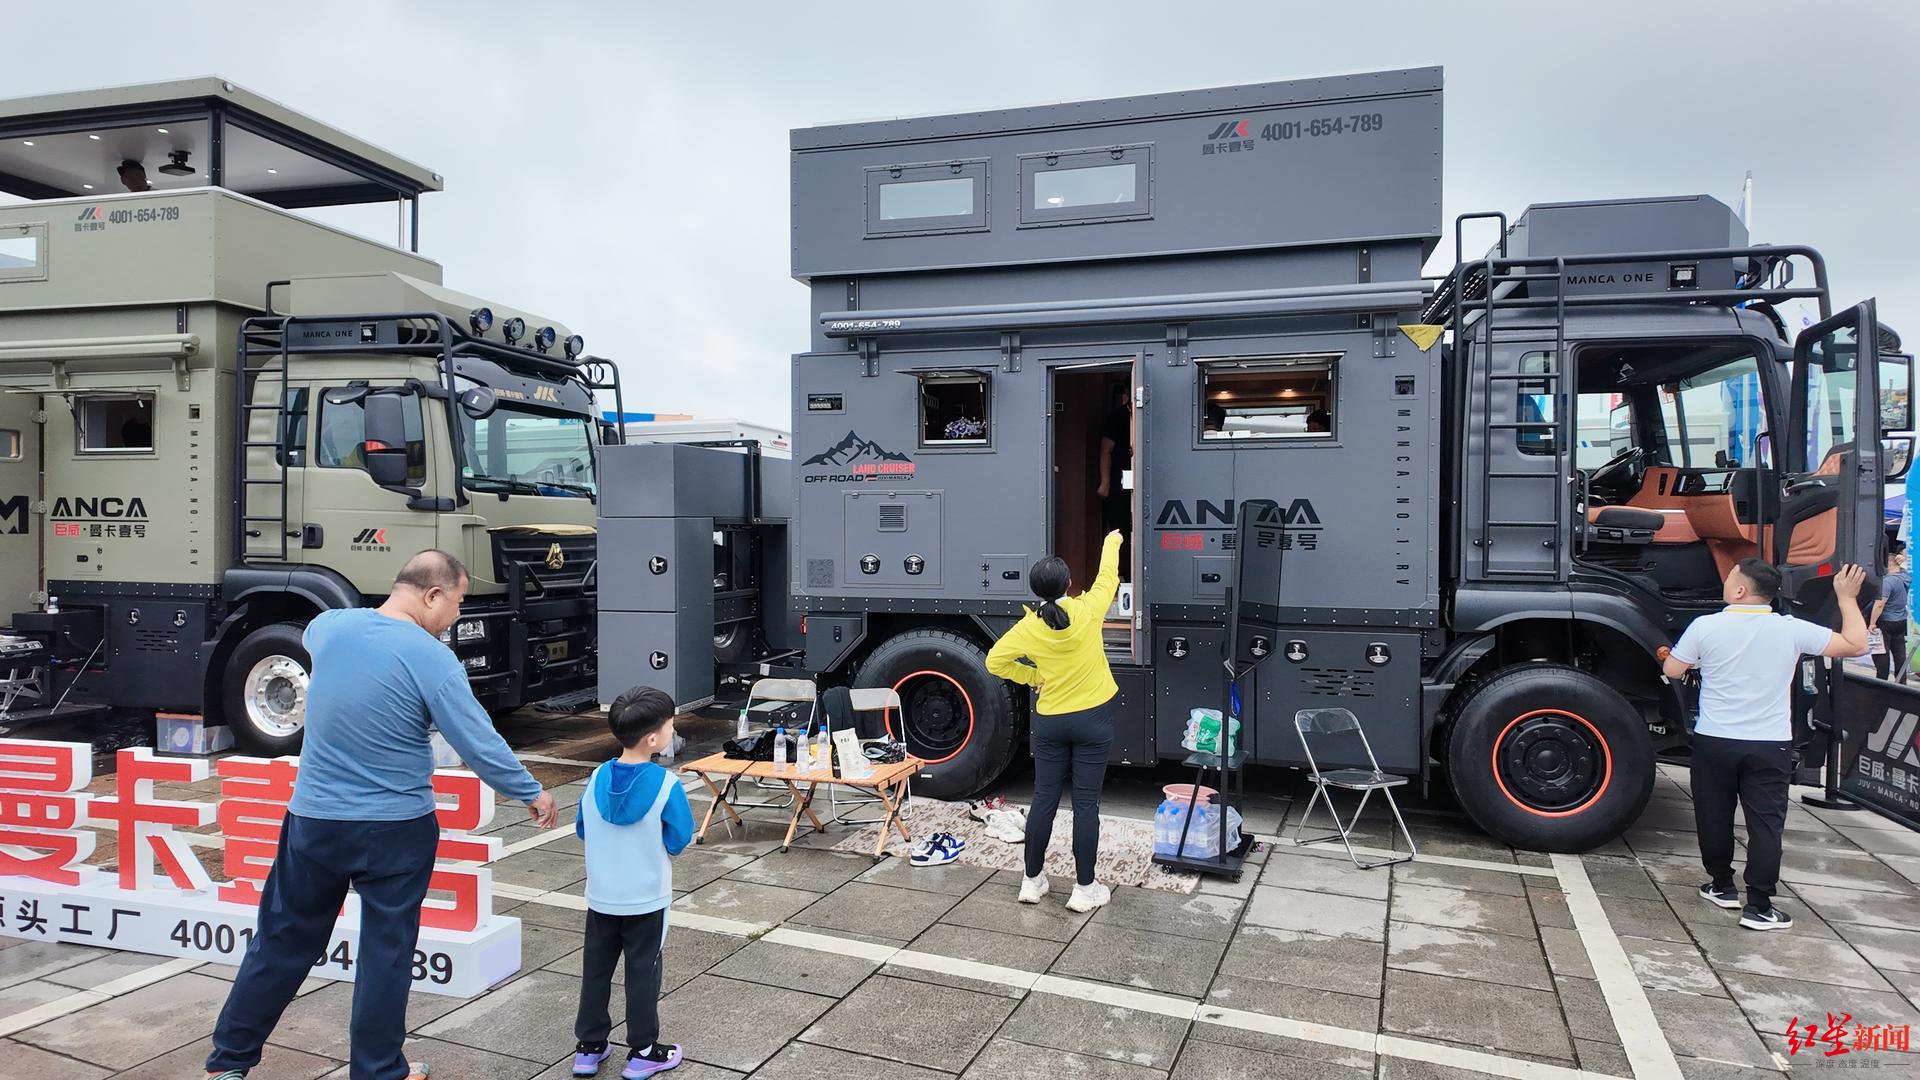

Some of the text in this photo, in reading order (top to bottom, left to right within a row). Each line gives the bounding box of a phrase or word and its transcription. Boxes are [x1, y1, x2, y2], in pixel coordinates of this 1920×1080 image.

[1260, 113, 1383, 141] 4001-654-789
[108, 206, 180, 224] 4001-654-789
[1567, 273, 1654, 285] MANCA ONE
[830, 320, 901, 331] 4001-654-789
[852, 463, 916, 474] LAND CRUISER
[805, 475, 827, 483] OFF
[829, 474, 864, 482] ROAD
[1156, 498, 1321, 525] ANA
[0, 896, 453, 985] 头工厂 4001489
